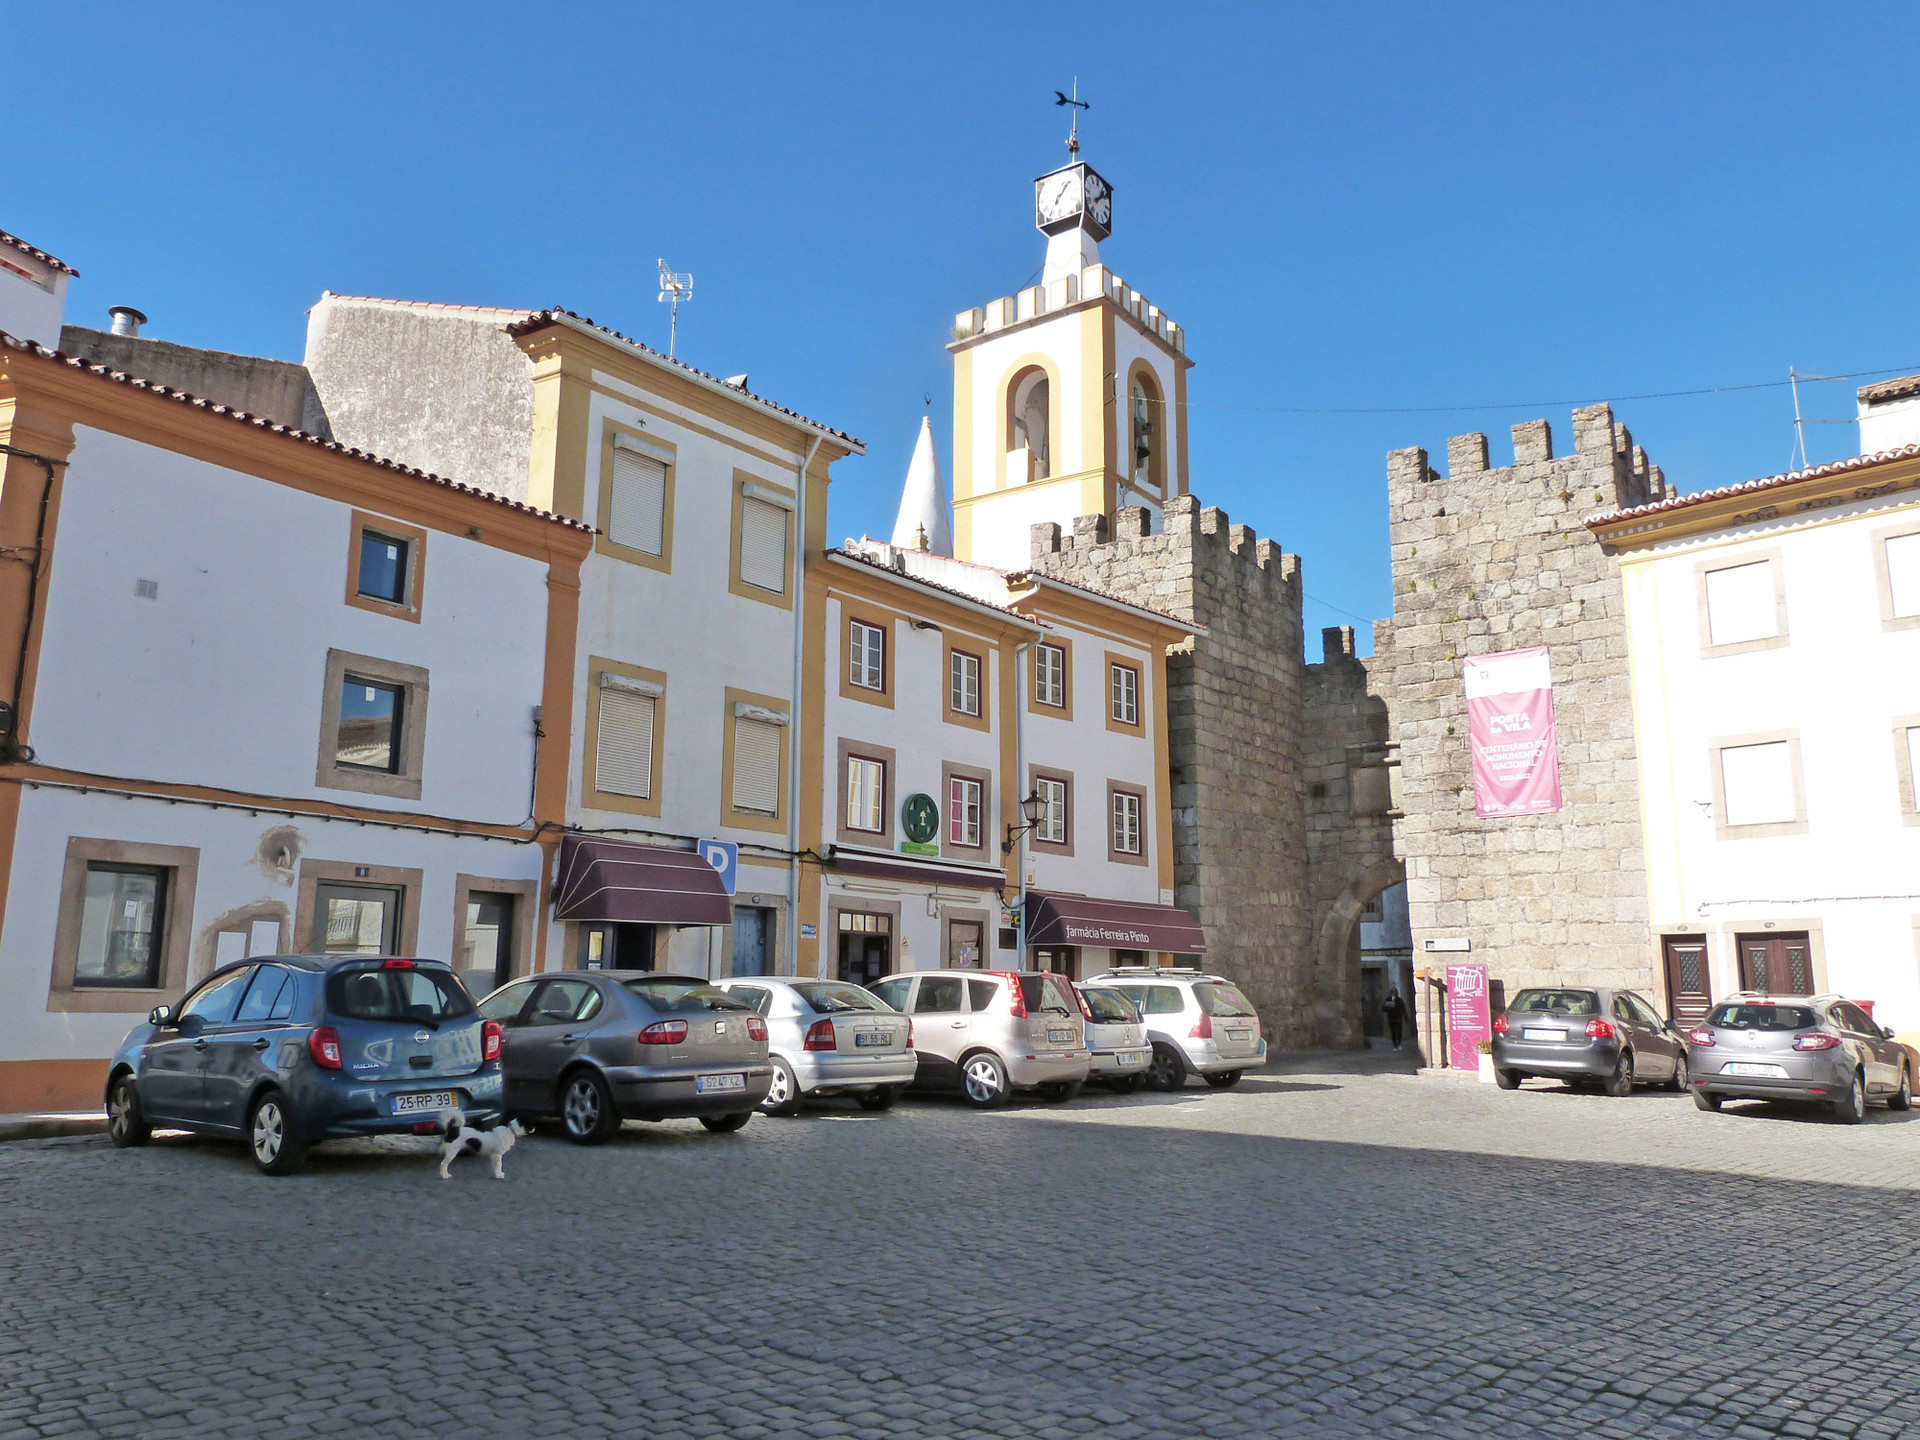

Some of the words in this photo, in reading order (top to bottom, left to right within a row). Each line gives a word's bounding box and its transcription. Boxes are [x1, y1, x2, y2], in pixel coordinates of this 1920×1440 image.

[1490, 712, 1530, 725] PORTA
[1503, 721, 1532, 732] VILA
[1480, 741, 1533, 754] CENTENÁRIO
[1535, 740, 1547, 748] DE
[1485, 750, 1542, 762] MONUMENTO
[1491, 759, 1536, 770] NACIONAL
[1066, 925, 1099, 939] farmácia
[1100, 928, 1130, 941] Ferreira
[1130, 930, 1150, 943] Pinto
